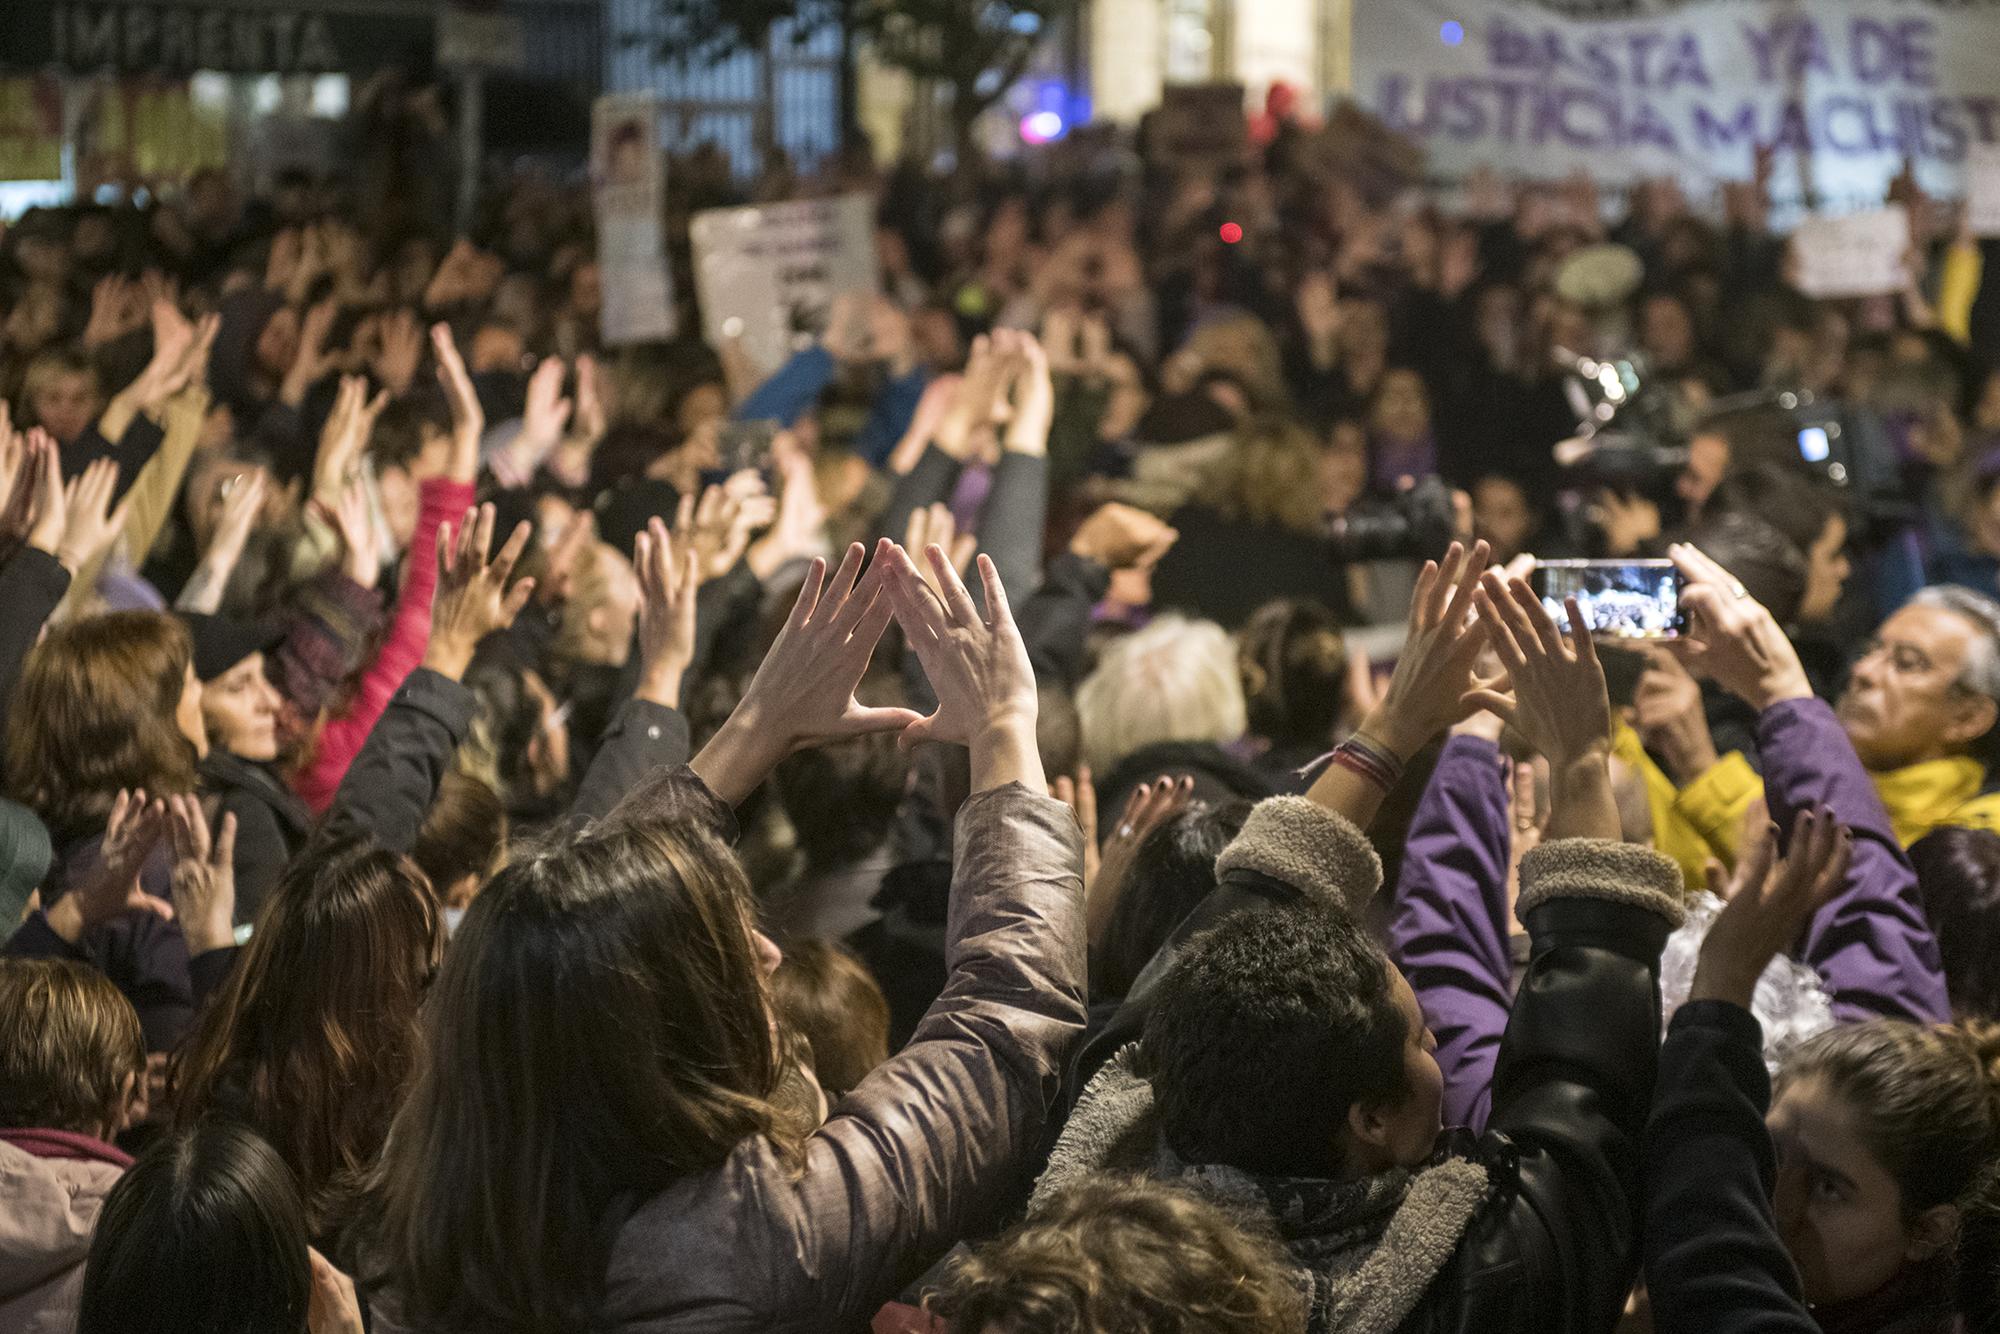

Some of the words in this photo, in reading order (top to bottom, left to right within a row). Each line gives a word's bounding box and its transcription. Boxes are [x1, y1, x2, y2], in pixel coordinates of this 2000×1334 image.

[1485, 16, 1712, 90] BASTA
[1741, 15, 1833, 84] YA
[1849, 17, 1936, 88] DE
